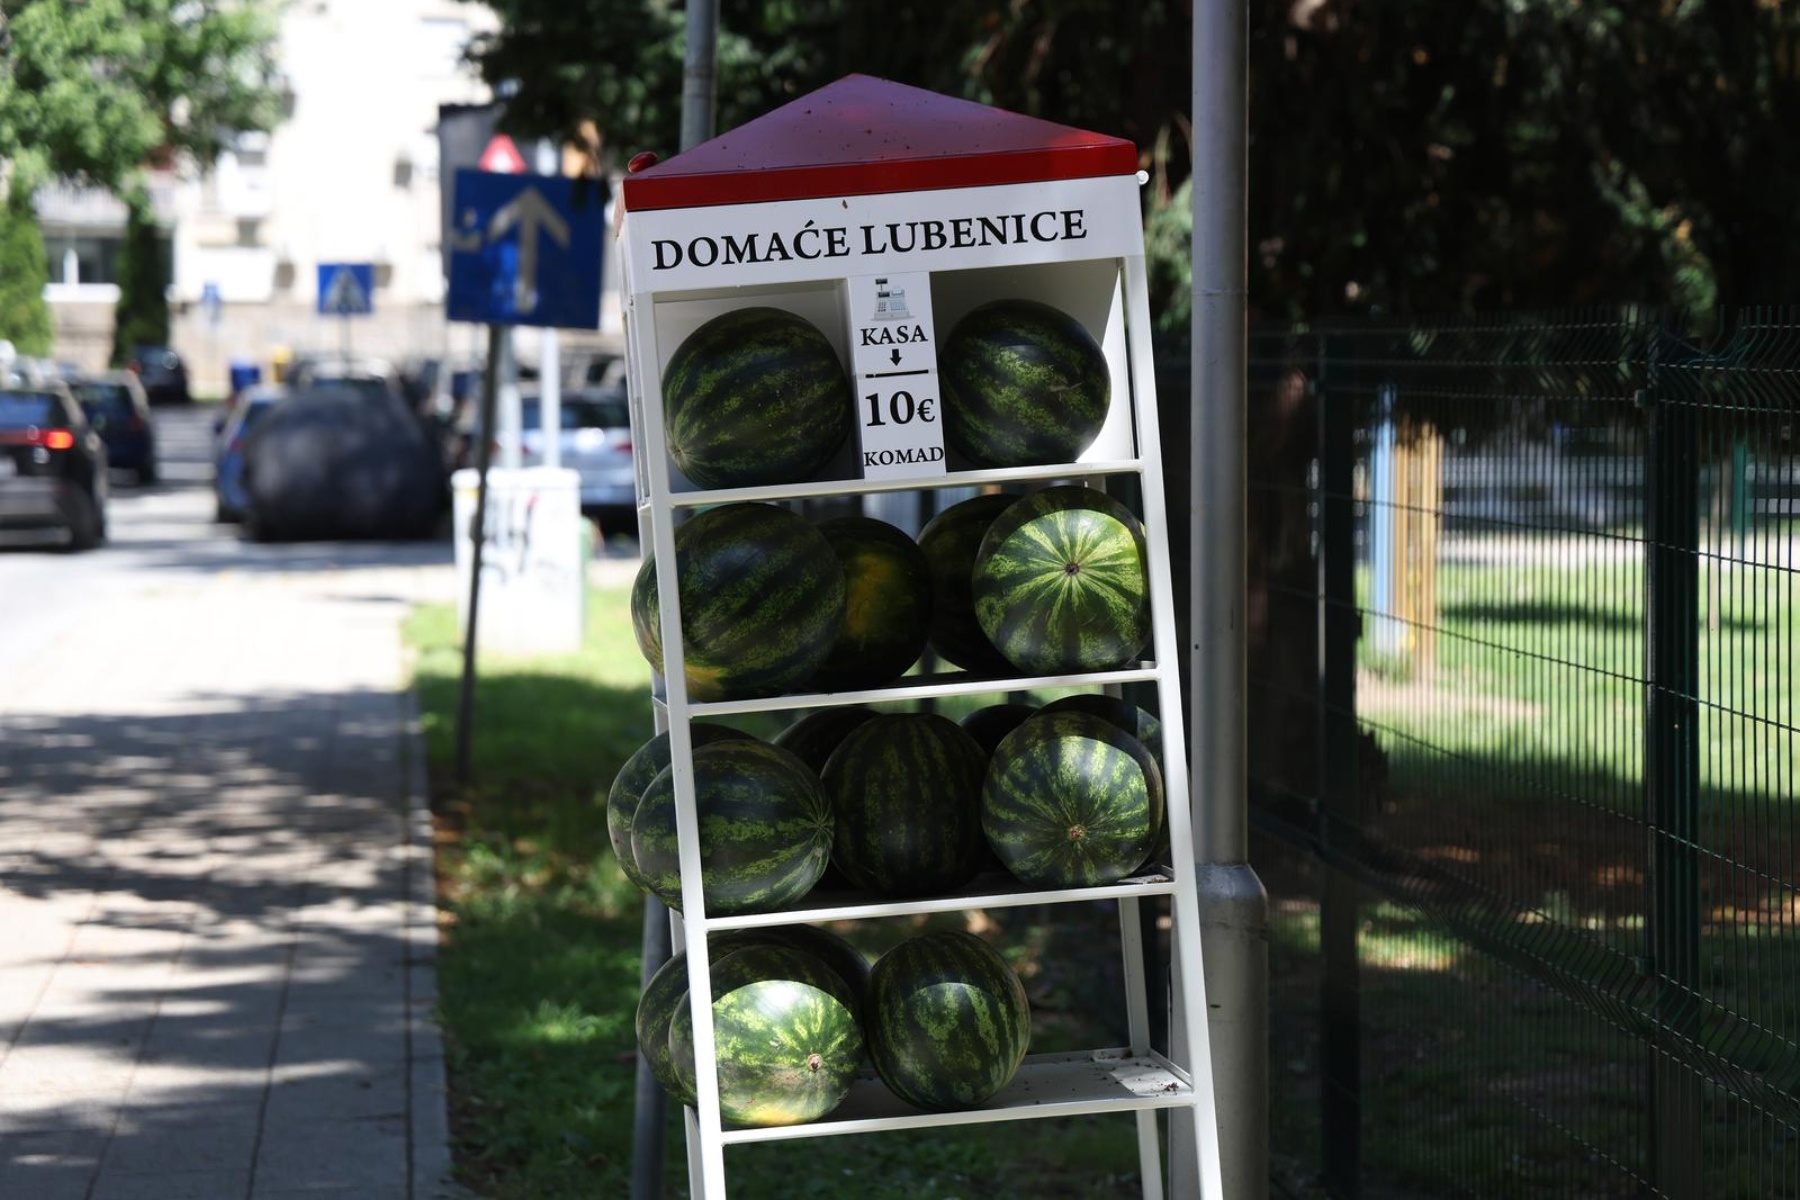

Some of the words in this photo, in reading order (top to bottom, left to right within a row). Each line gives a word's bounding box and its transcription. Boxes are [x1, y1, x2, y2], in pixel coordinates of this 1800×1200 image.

[651, 219, 851, 271] DOMAĆE
[859, 209, 1088, 255] LUBENICE
[860, 324, 929, 346] KASA
[865, 390, 936, 427] 10€
[864, 446, 945, 467] KOMAD
